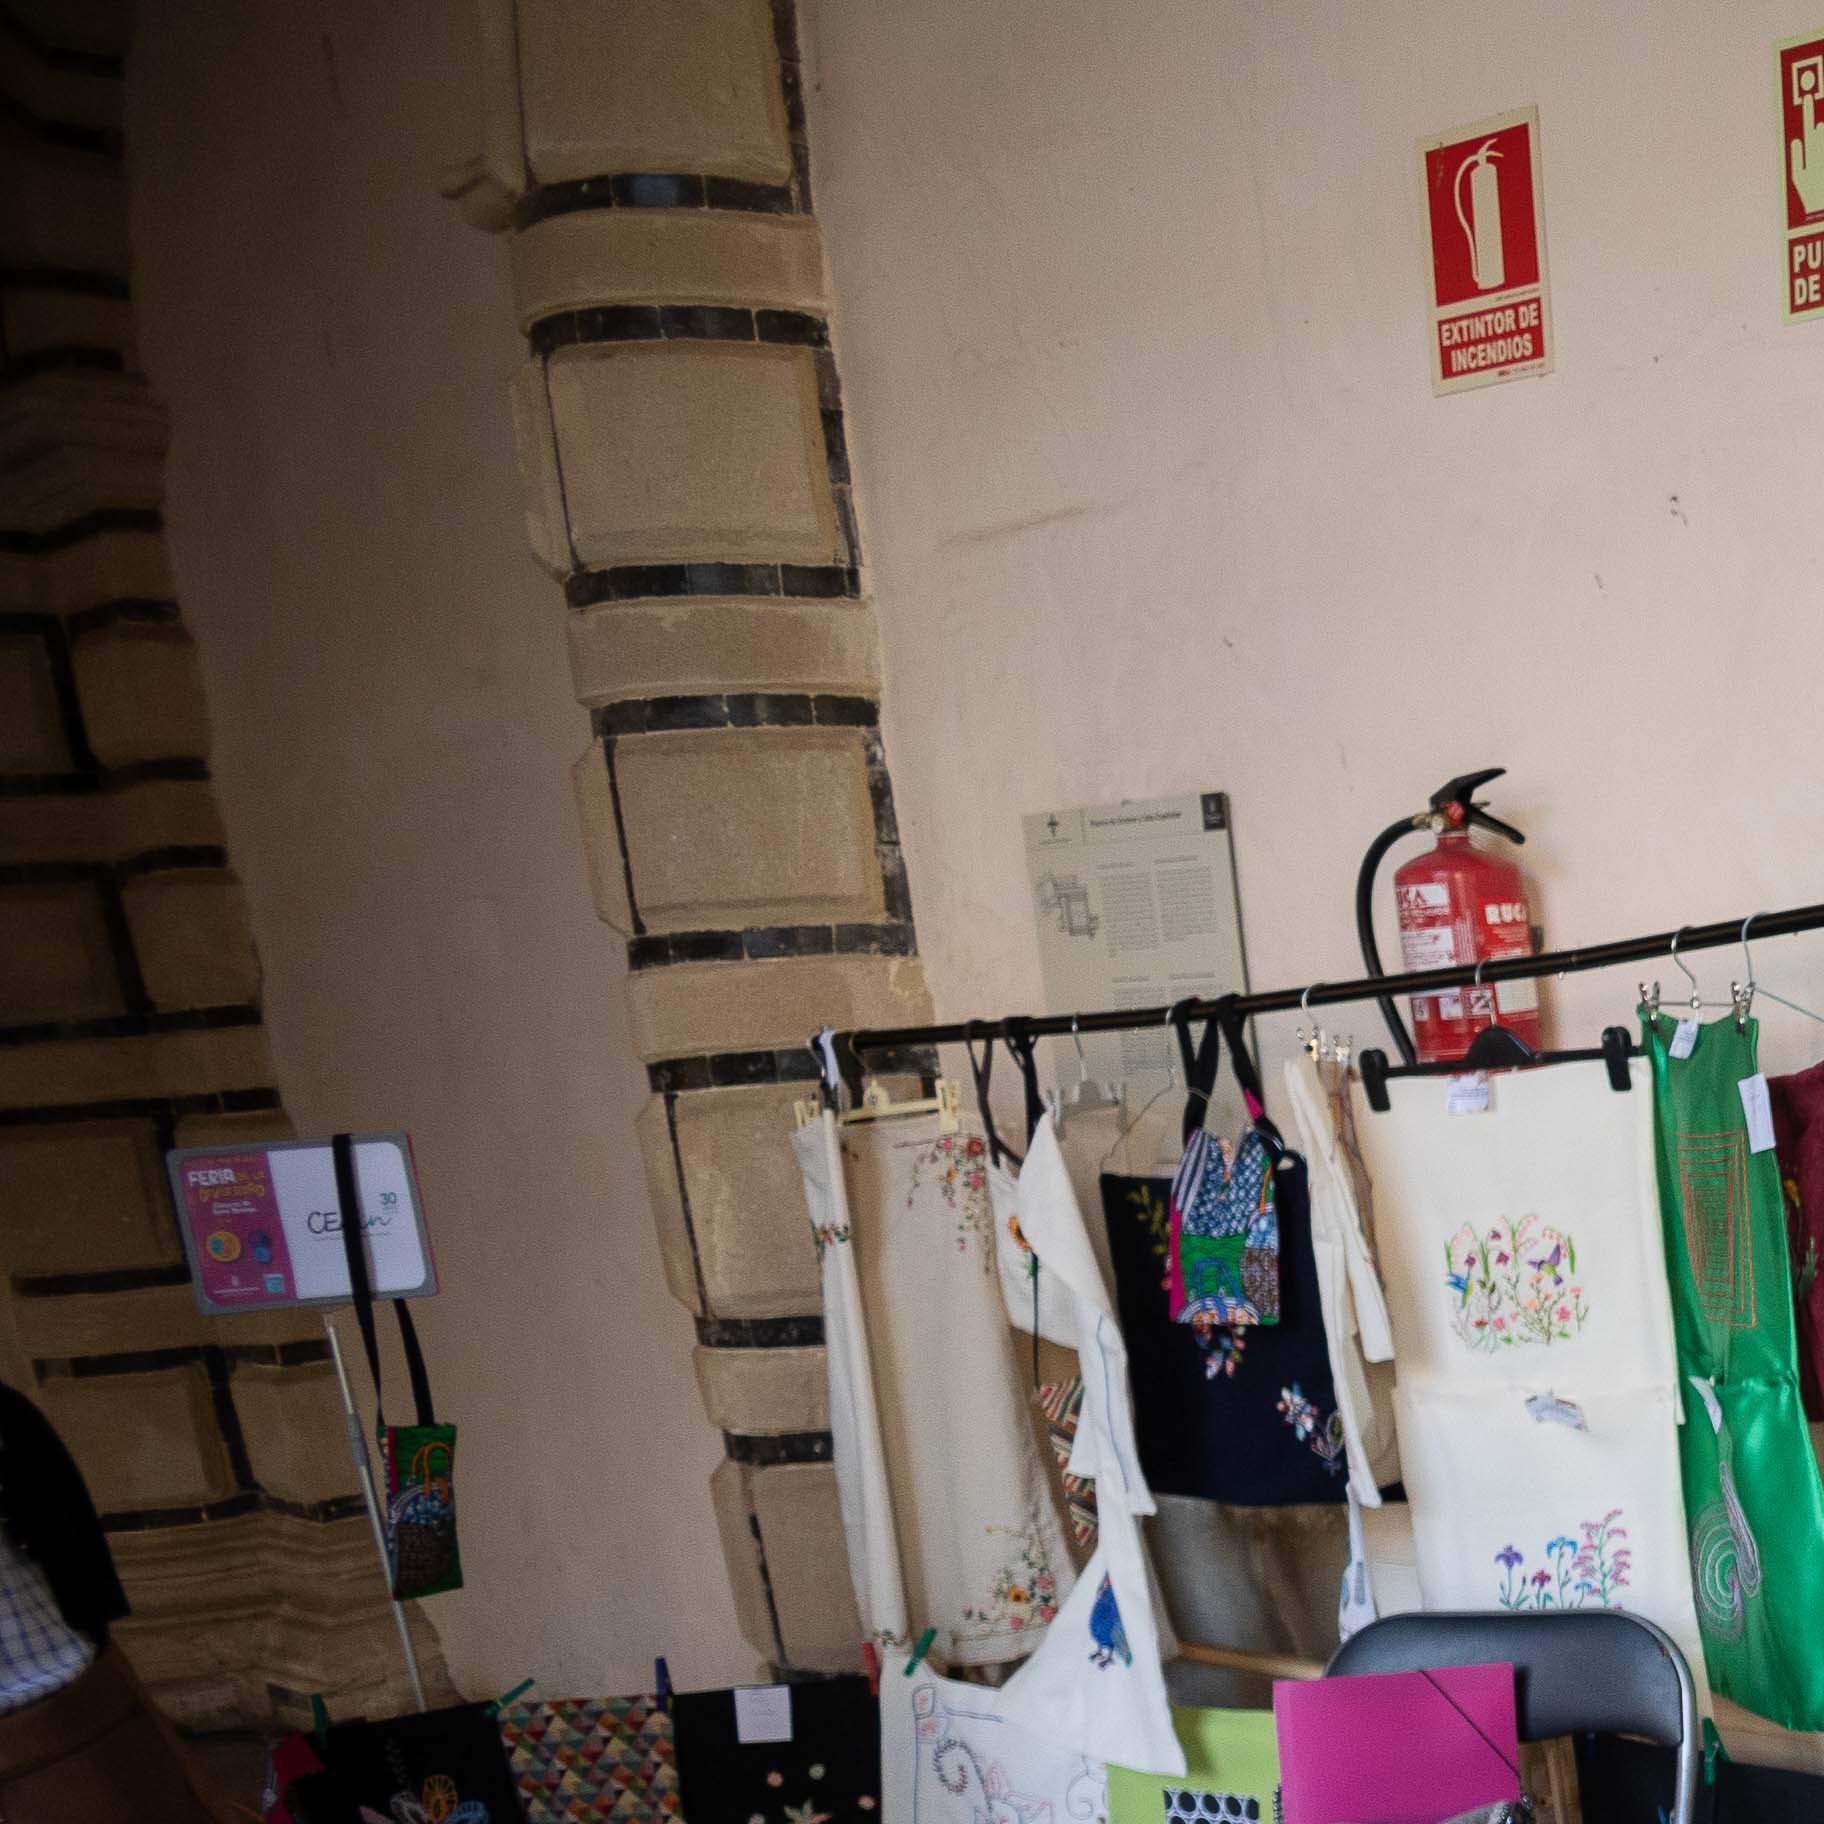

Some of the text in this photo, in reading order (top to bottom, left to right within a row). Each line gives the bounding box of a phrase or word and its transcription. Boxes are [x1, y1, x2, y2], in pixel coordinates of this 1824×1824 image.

[1794, 276, 1821, 305] DE
[1440, 303, 1540, 349] EXTINTOR DE
[1451, 334, 1534, 373] INCENDIOS
[380, 1192, 397, 1206] 30
